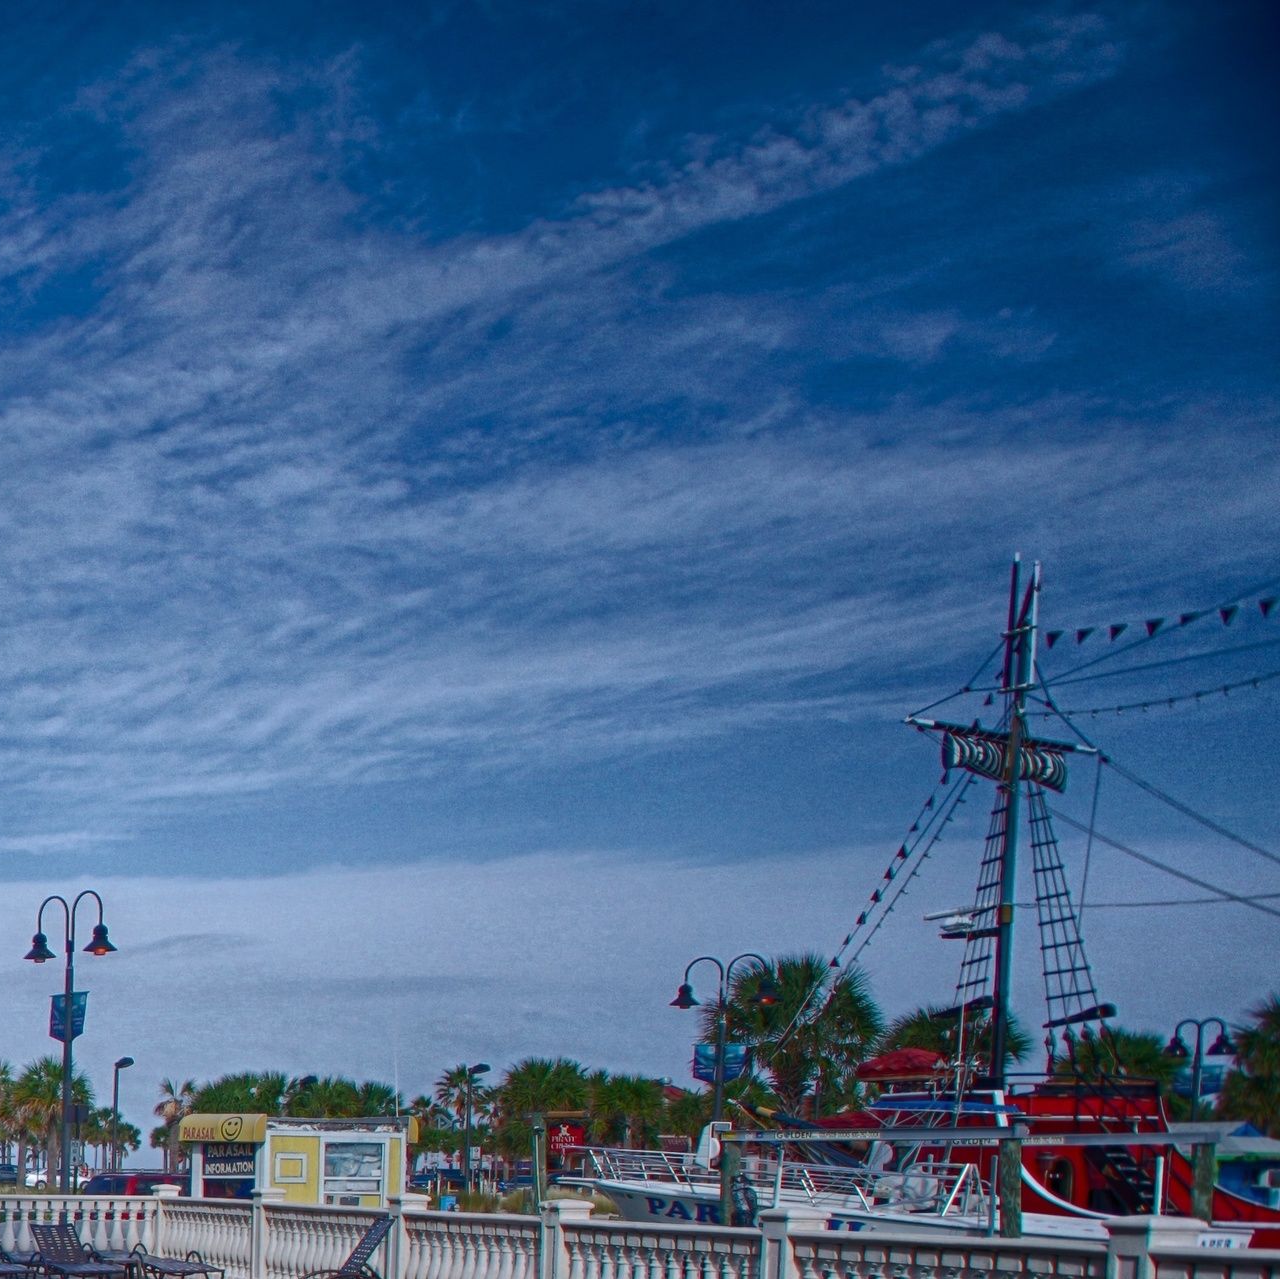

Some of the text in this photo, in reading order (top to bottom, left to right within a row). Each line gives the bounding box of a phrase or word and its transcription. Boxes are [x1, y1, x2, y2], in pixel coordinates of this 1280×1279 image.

[183, 1127, 215, 1139] PARASAIL
[207, 1144, 253, 1158] PARASAIL
[205, 1161, 254, 1174] INFORMATION
